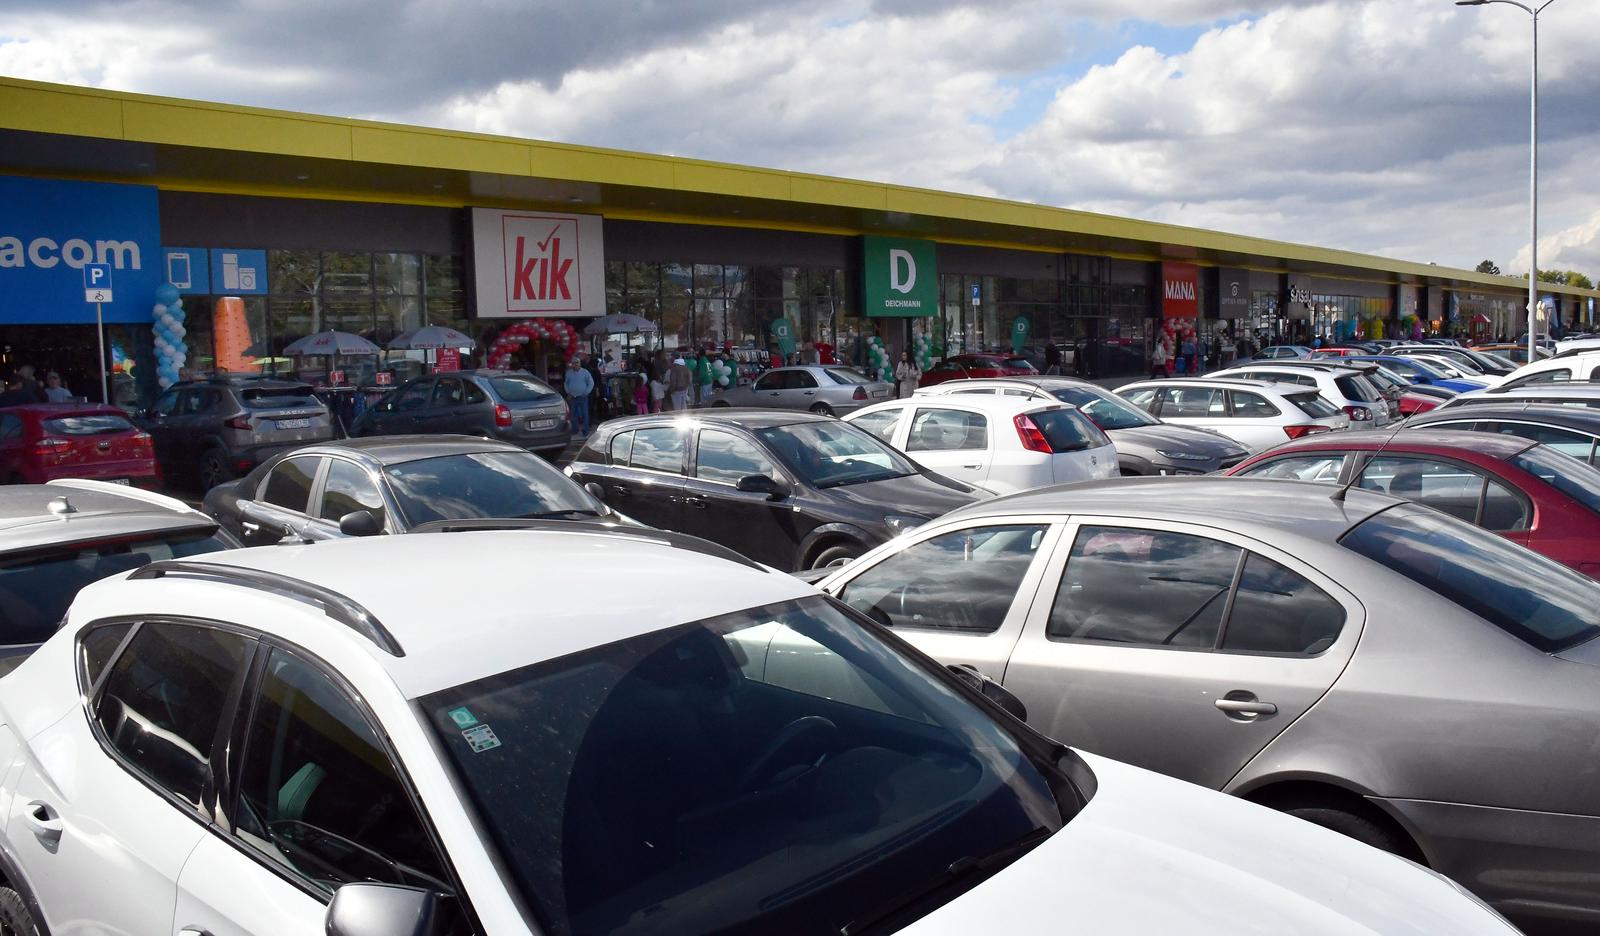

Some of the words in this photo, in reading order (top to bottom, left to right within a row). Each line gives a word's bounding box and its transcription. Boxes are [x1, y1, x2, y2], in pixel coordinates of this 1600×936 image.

[0, 236, 141, 269] acom
[513, 224, 573, 300] kik
[91, 268, 104, 284] P
[890, 249, 916, 294] D
[1165, 280, 1195, 300] MANA
